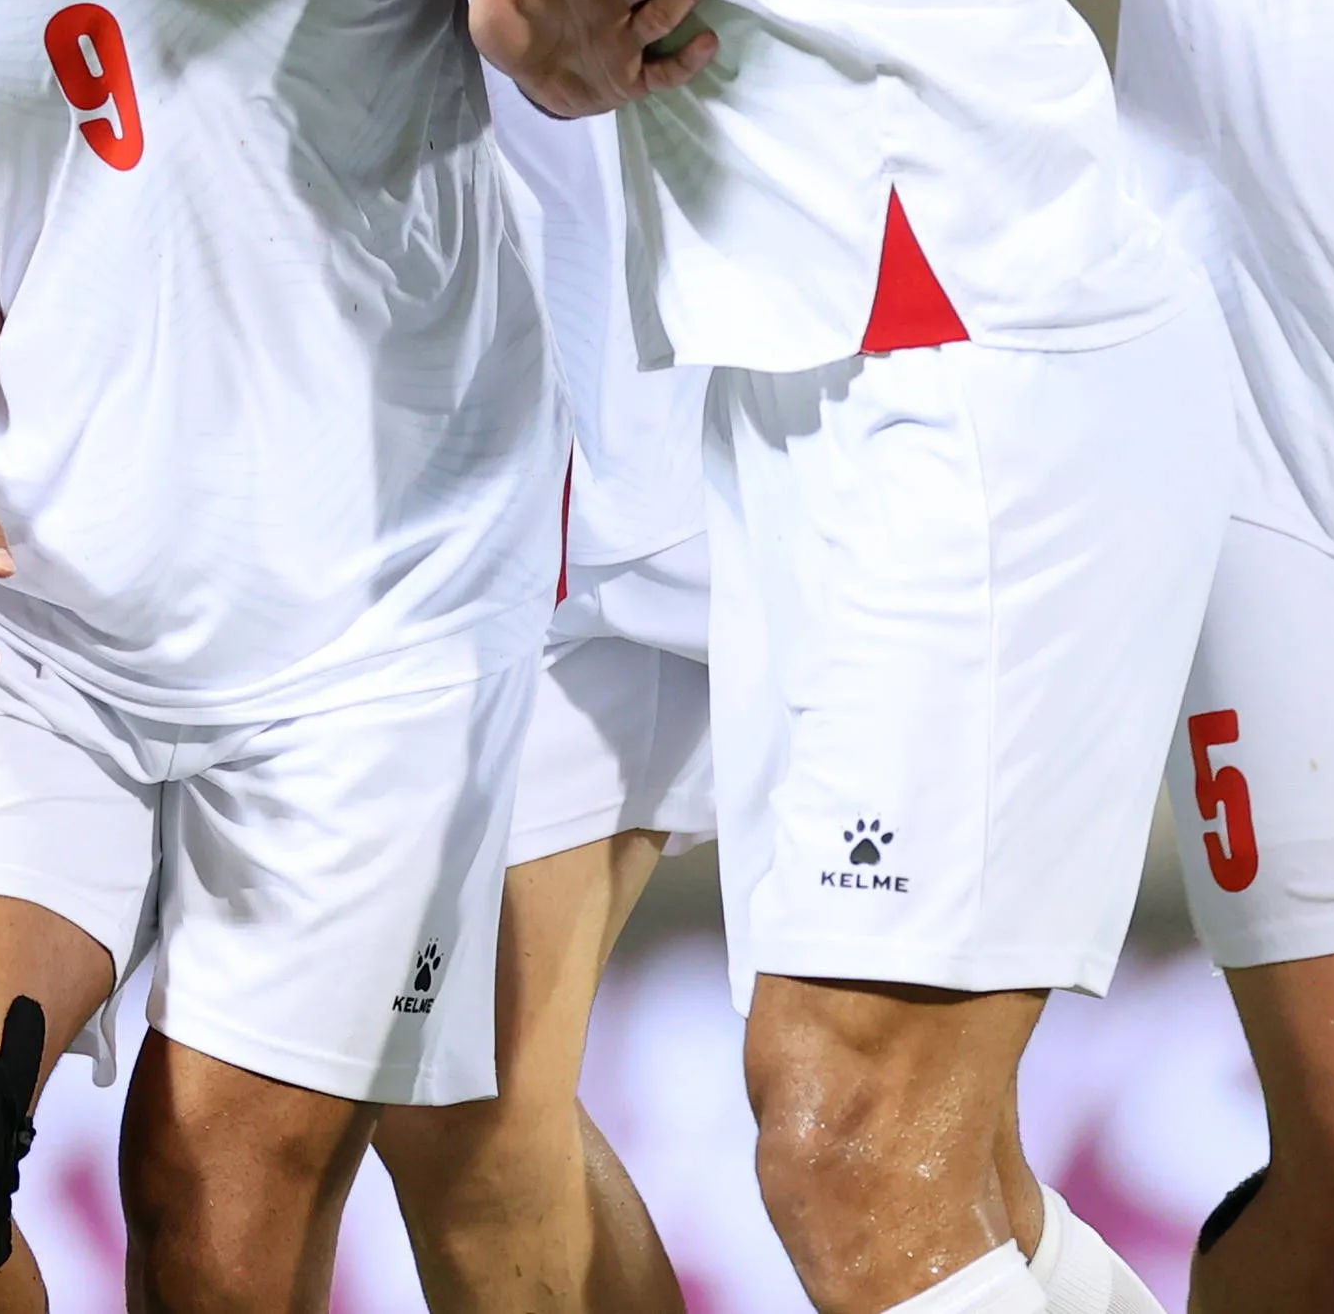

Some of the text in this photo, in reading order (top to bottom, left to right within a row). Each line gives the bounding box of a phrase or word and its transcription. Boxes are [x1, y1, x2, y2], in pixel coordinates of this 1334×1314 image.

[45, 3, 145, 172] 9
[1189, 709, 1258, 892] 5
[820, 871, 910, 894] KELME
[392, 995, 435, 1014] KELME
